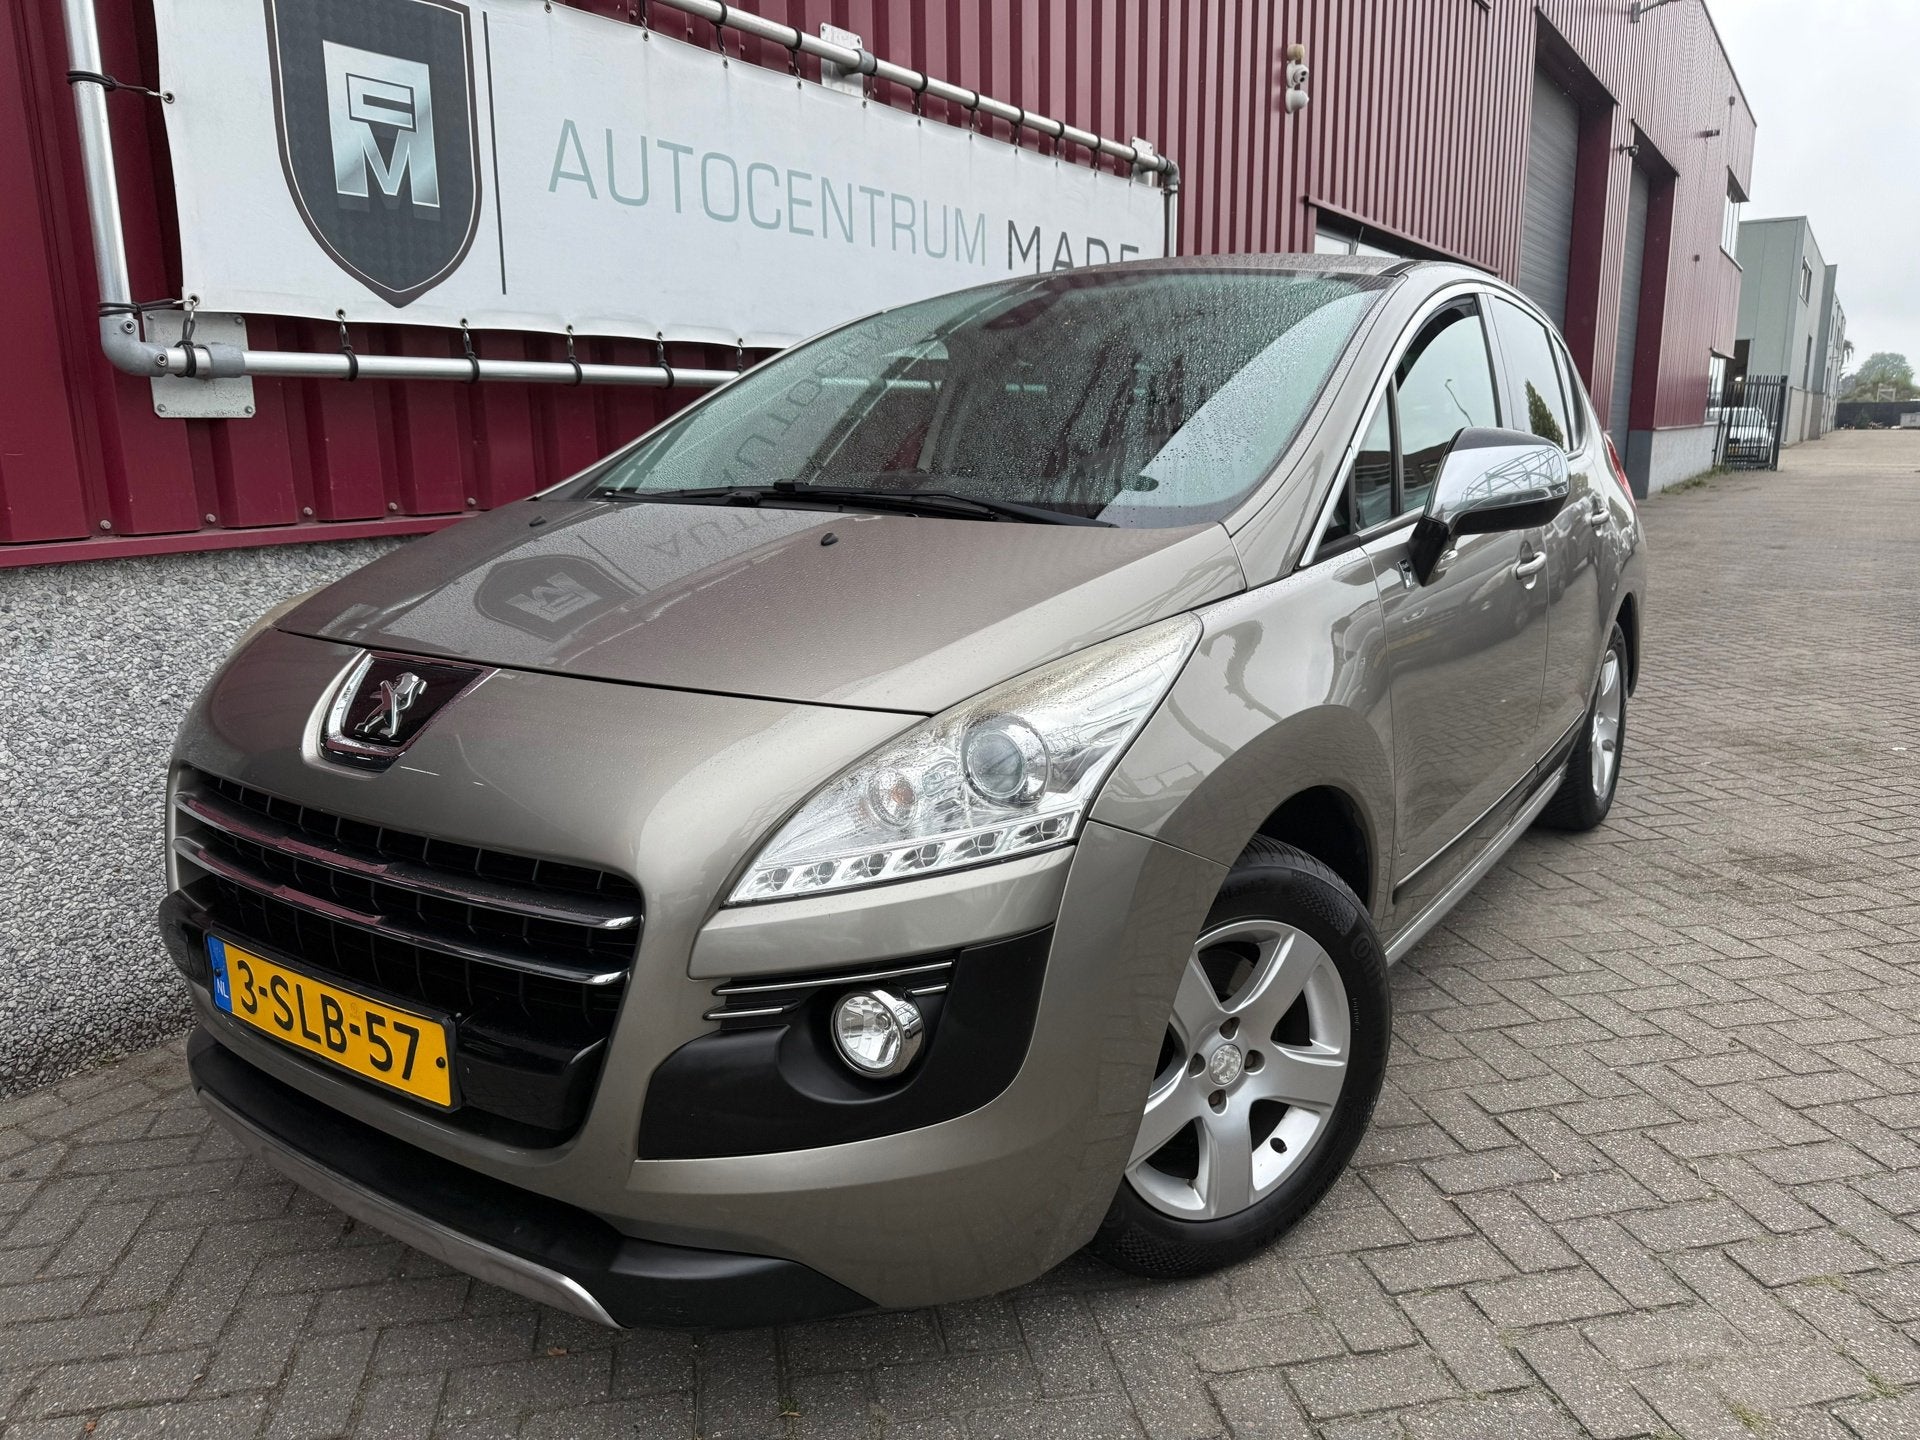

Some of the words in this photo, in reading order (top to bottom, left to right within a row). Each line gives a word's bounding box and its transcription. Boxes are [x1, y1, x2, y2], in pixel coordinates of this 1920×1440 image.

[548, 118, 986, 267] AUTOCENTRUM
[216, 978, 229, 999] NL
[237, 959, 420, 1081] 3-SLB-57
